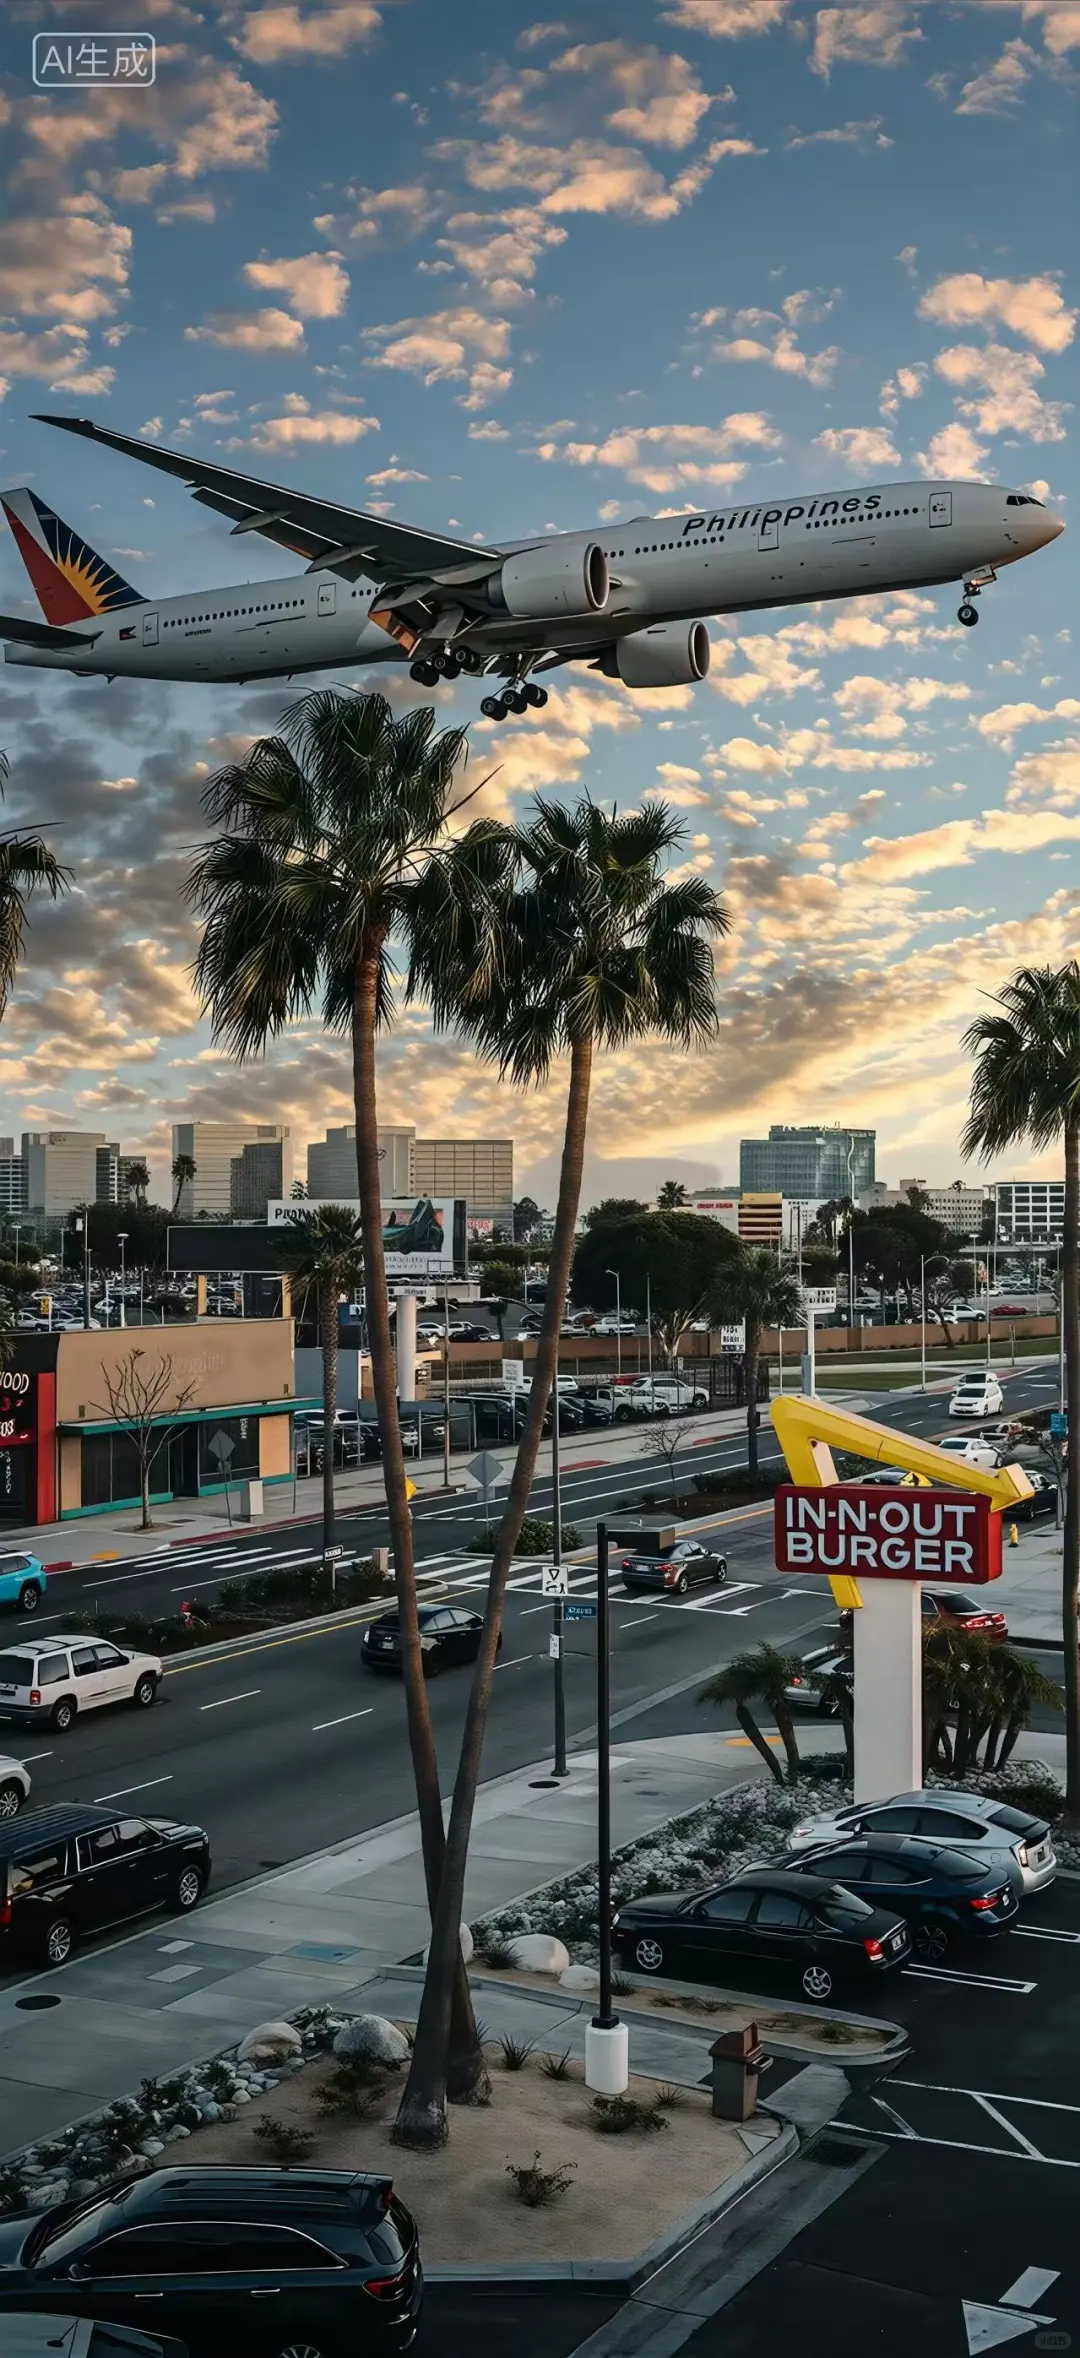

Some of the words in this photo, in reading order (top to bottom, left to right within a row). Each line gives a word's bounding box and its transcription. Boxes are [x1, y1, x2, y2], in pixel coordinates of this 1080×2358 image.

[682, 495, 881, 536] Philippines
[0, 1371, 29, 1395] OOD
[786, 1496, 977, 1537] IN-N-OUT
[786, 1531, 974, 1574] BURGER
